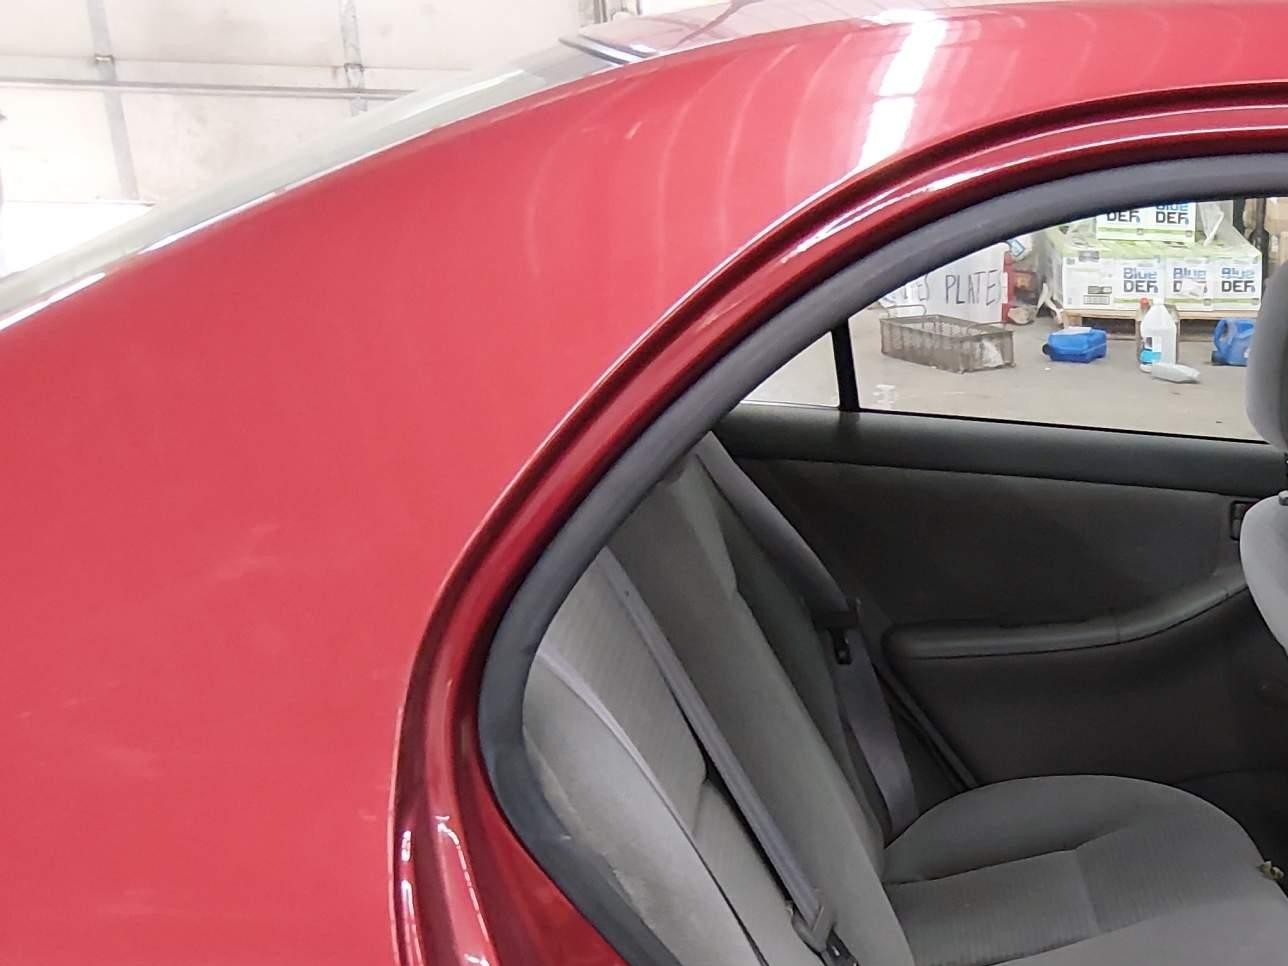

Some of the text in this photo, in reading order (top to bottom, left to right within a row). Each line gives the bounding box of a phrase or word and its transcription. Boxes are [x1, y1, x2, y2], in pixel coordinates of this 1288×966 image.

[1155, 211, 1189, 224] DEF
[1123, 267, 1158, 280] Blue
[1173, 267, 1206, 280] Blue
[1221, 267, 1255, 280] Blue
[1123, 280, 1158, 293] DEF
[1221, 280, 1256, 293] DEF
